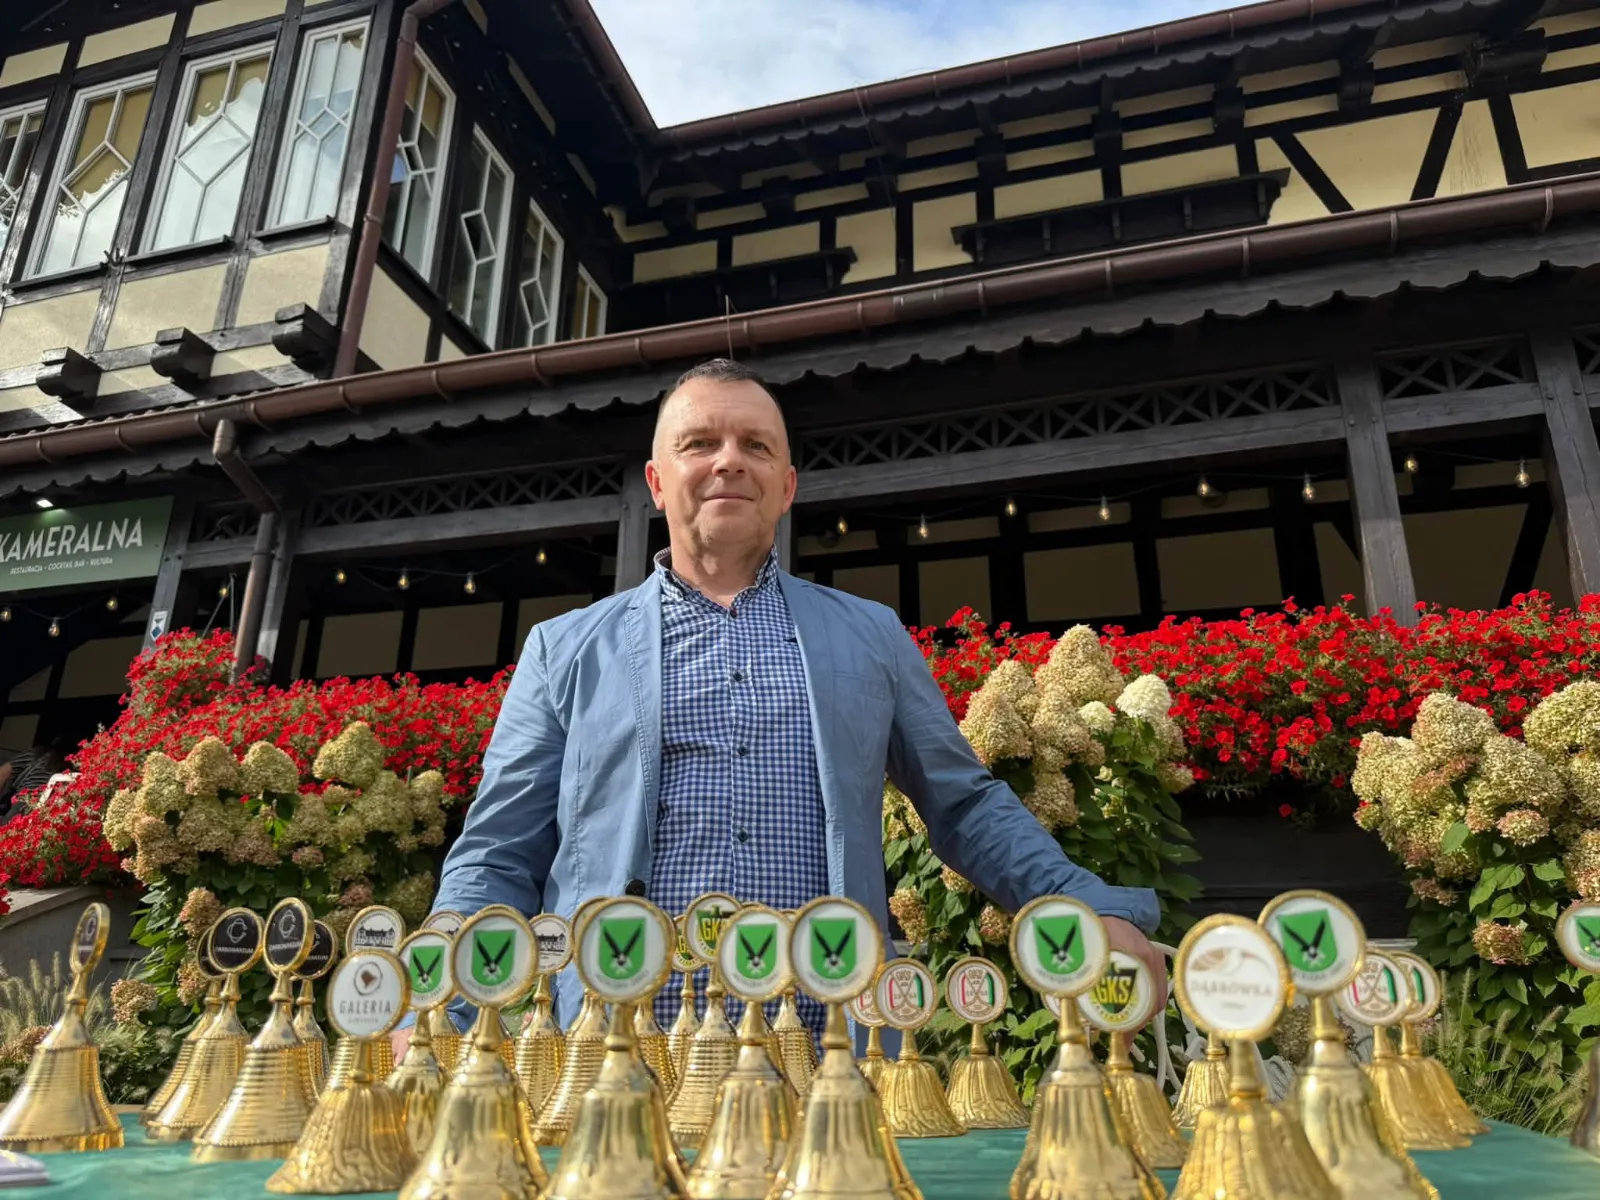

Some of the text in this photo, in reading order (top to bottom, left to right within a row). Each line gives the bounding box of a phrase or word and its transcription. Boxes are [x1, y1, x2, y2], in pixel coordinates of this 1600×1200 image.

[0, 517, 143, 562] KAMERALNA
[1097, 975, 1132, 1004] GKS
[340, 1000, 392, 1015] GALERIA
